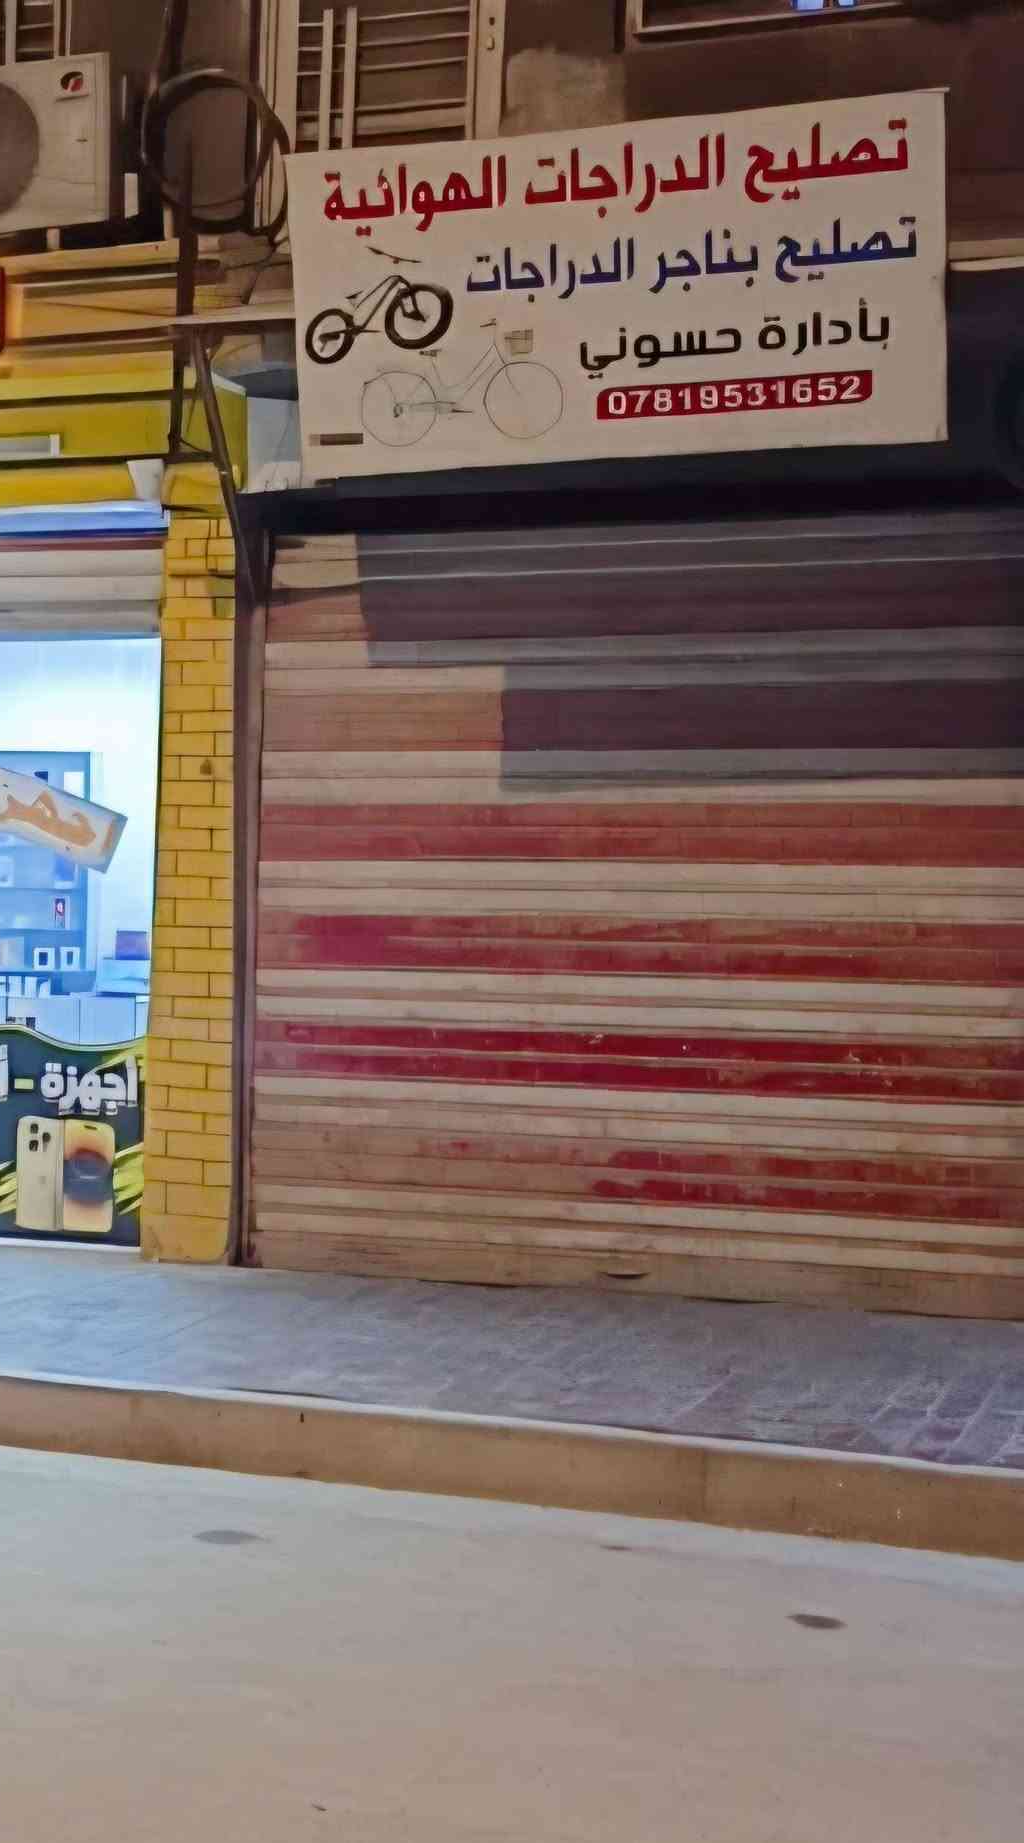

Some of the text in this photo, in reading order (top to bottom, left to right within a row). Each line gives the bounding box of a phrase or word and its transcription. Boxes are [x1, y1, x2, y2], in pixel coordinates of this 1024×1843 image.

[323, 117, 908, 237] تصليح الدراجات الهوائية
[466, 215, 917, 303] تصليح بناجر الدراجات
[579, 297, 890, 380] بأدارة حسوني
[607, 374, 861, 416] 07819531652
